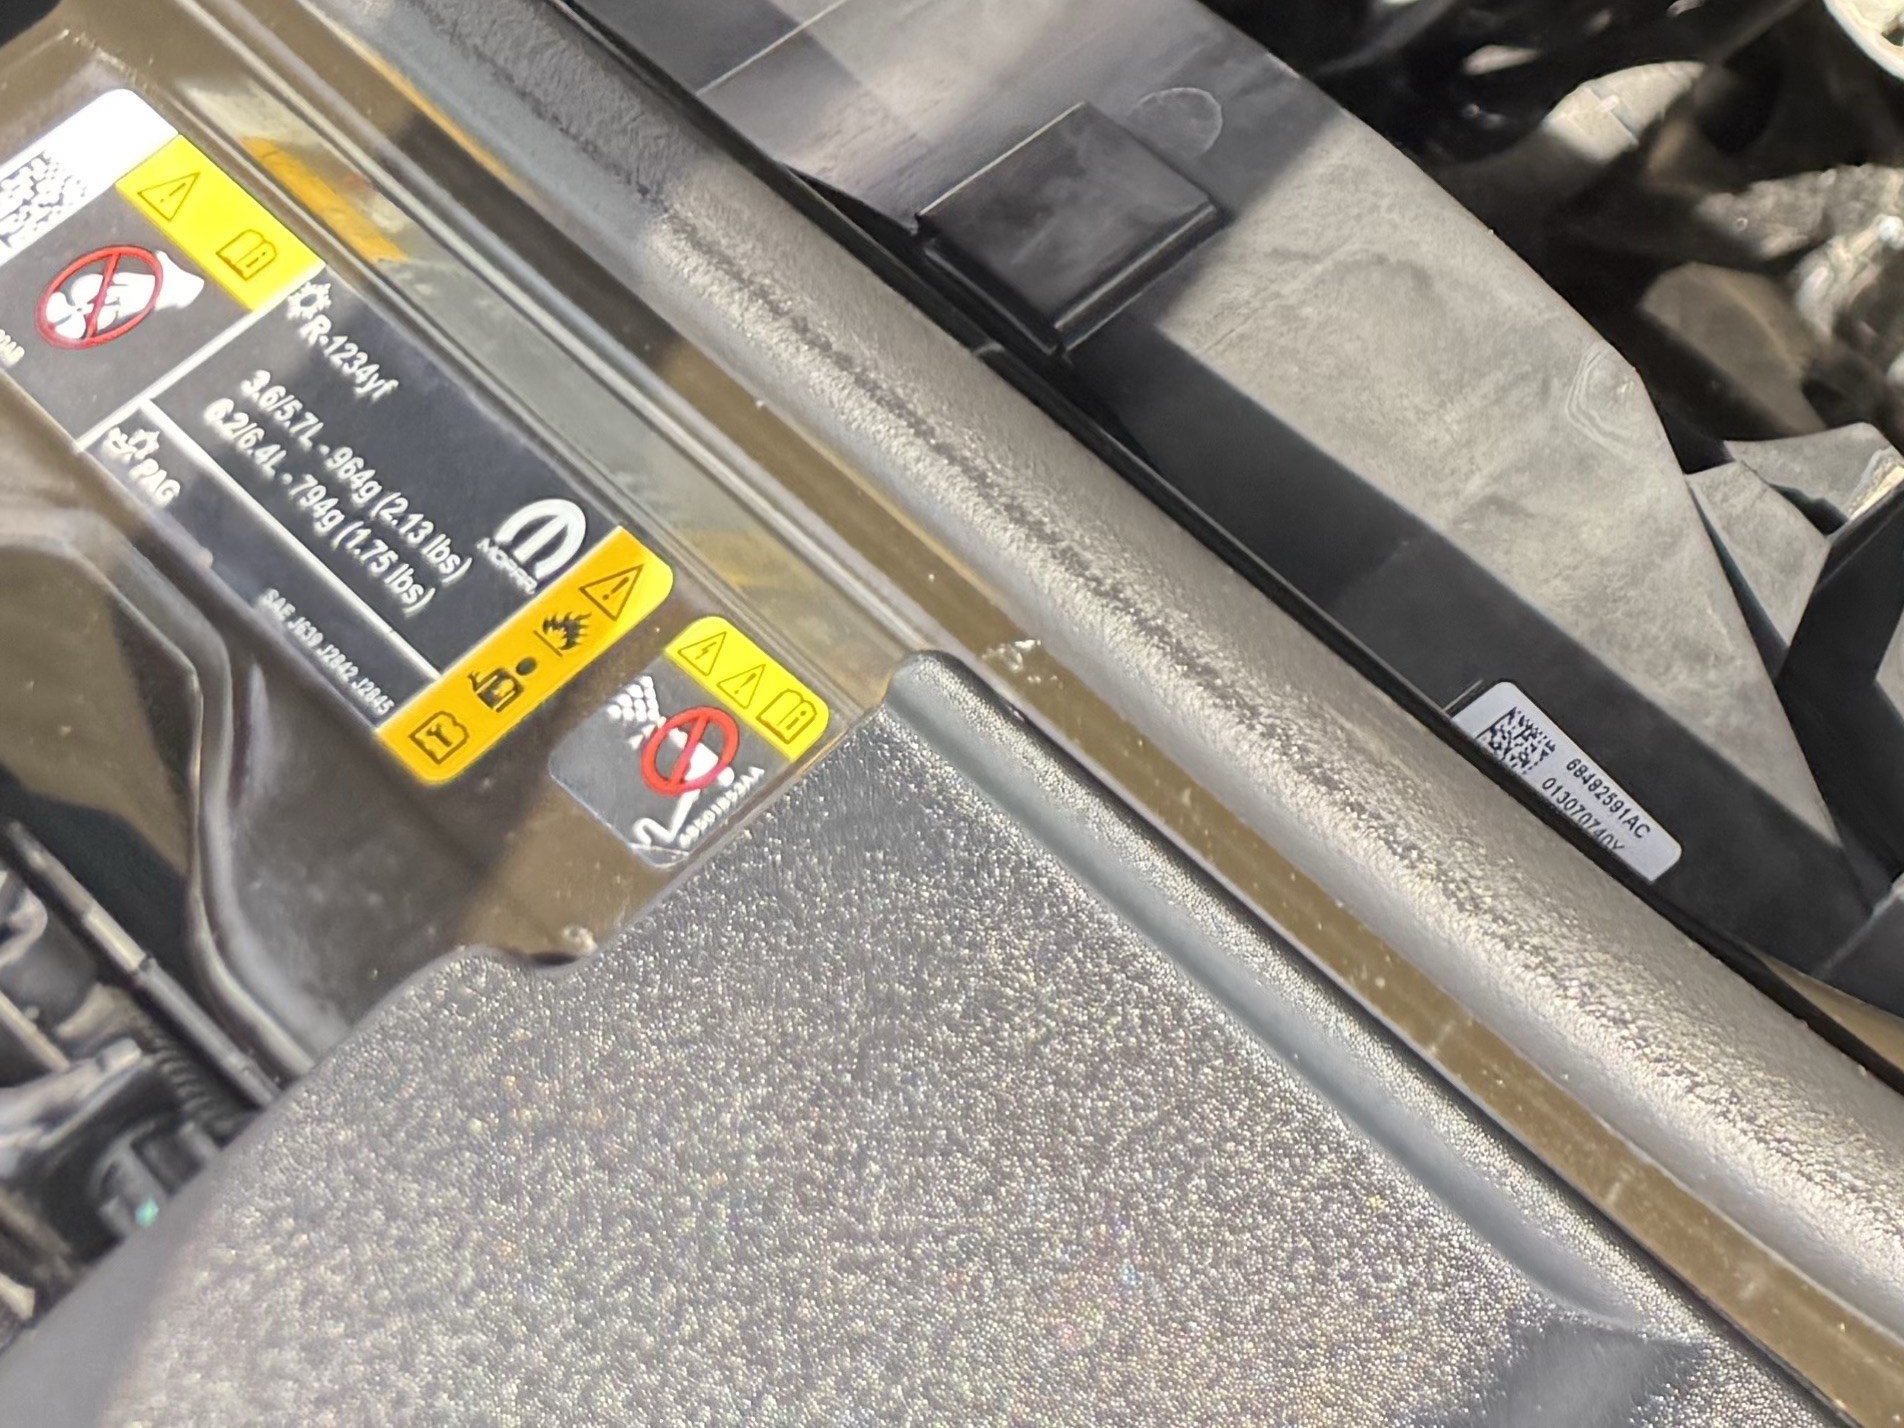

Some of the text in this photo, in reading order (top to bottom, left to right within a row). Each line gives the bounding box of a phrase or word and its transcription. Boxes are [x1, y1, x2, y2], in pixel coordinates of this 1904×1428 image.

[295, 314, 398, 400] R-1234yf
[128, 458, 180, 508] PAG
[201, 398, 286, 478] 6.2/6.4L
[289, 474, 345, 536] 794g
[332, 521, 398, 576] (1.75
[383, 564, 435, 617] lbs)
[236, 369, 323, 450] 3.6/5.7L
[325, 447, 383, 507] 964g
[370, 492, 433, 547] (2.13
[421, 534, 472, 585] lbs)
[477, 538, 537, 594] MOPAR
[258, 589, 394, 715] SAE J639 J2842 J2845
[1566, 759, 1650, 838] 68482591AC
